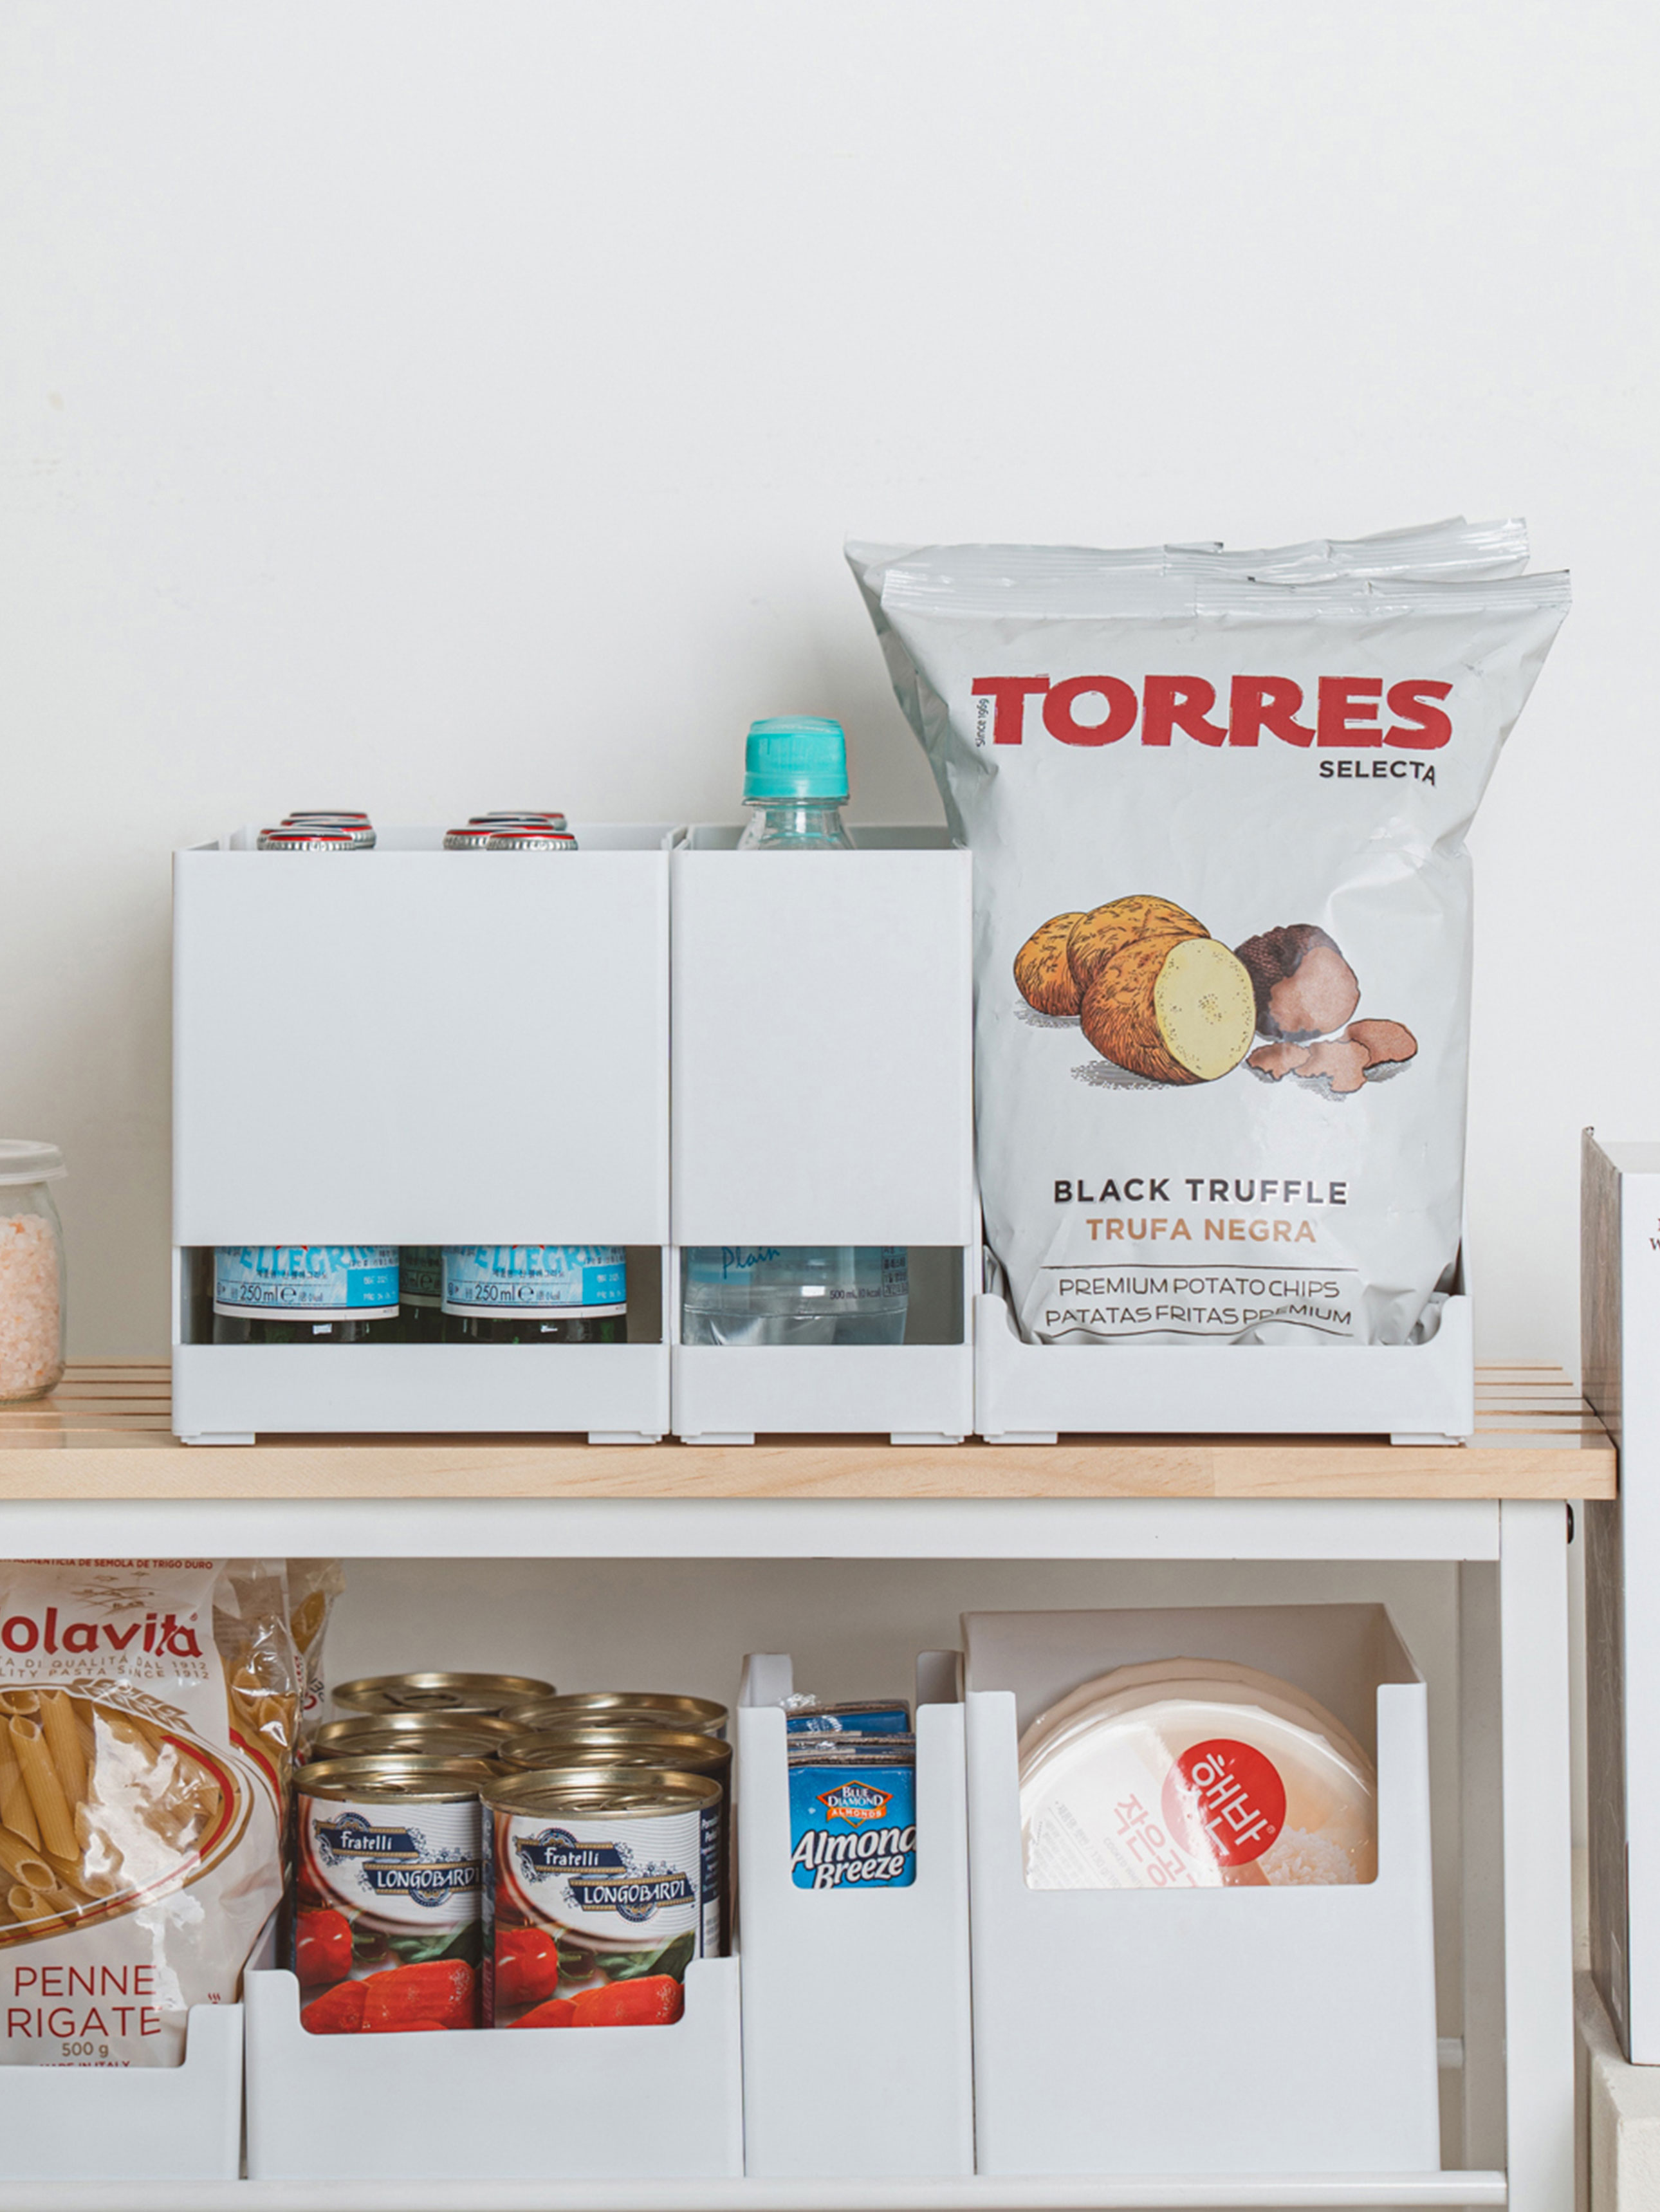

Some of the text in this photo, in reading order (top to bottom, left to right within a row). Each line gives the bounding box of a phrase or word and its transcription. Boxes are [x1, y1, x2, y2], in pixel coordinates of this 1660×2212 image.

[971, 674, 1453, 750] TORRES
[975, 698, 990, 747] Since 1969
[1319, 760, 1435, 786] SELECTA
[1055, 1179, 1348, 1205] BLACK TRUFFLE
[1086, 1219, 1316, 1243] TRUFA NEGRA
[721, 1246, 780, 1280] Plain
[1059, 1278, 1340, 1298] PREMIUM POTATO CHIPS
[1046, 1307, 1152, 1326] PATATAS
[1156, 1305, 1239, 1325] FRITAS
[78, 1558, 92, 1567] DE
[94, 1558, 134, 1568] SEMOLA
[136, 1559, 149, 1568] DE
[153, 1559, 182, 1569] TRIGO
[184, 1560, 213, 1570] DURO
[48, 1667, 106, 1677] PASTA
[118, 1665, 165, 1679] SINCE
[136, 1656, 163, 1669] DAL
[172, 1661, 207, 1670] 1912
[827, 1794, 884, 1807] DIAMOND
[842, 1786, 869, 1798] BLUE
[831, 1808, 882, 1819] ALMONDS
[340, 1830, 392, 1850] fratelli
[544, 1847, 599, 1866] fratelli
[377, 1867, 480, 1889] LONGOBARDI
[813, 1854, 905, 1889] Breeze
[584, 1880, 685, 1904] LONGOBARDI
[14, 1964, 157, 1996] PENNE
[7, 2006, 162, 2038] RIGATE
[62, 2041, 109, 2058] 500 g
